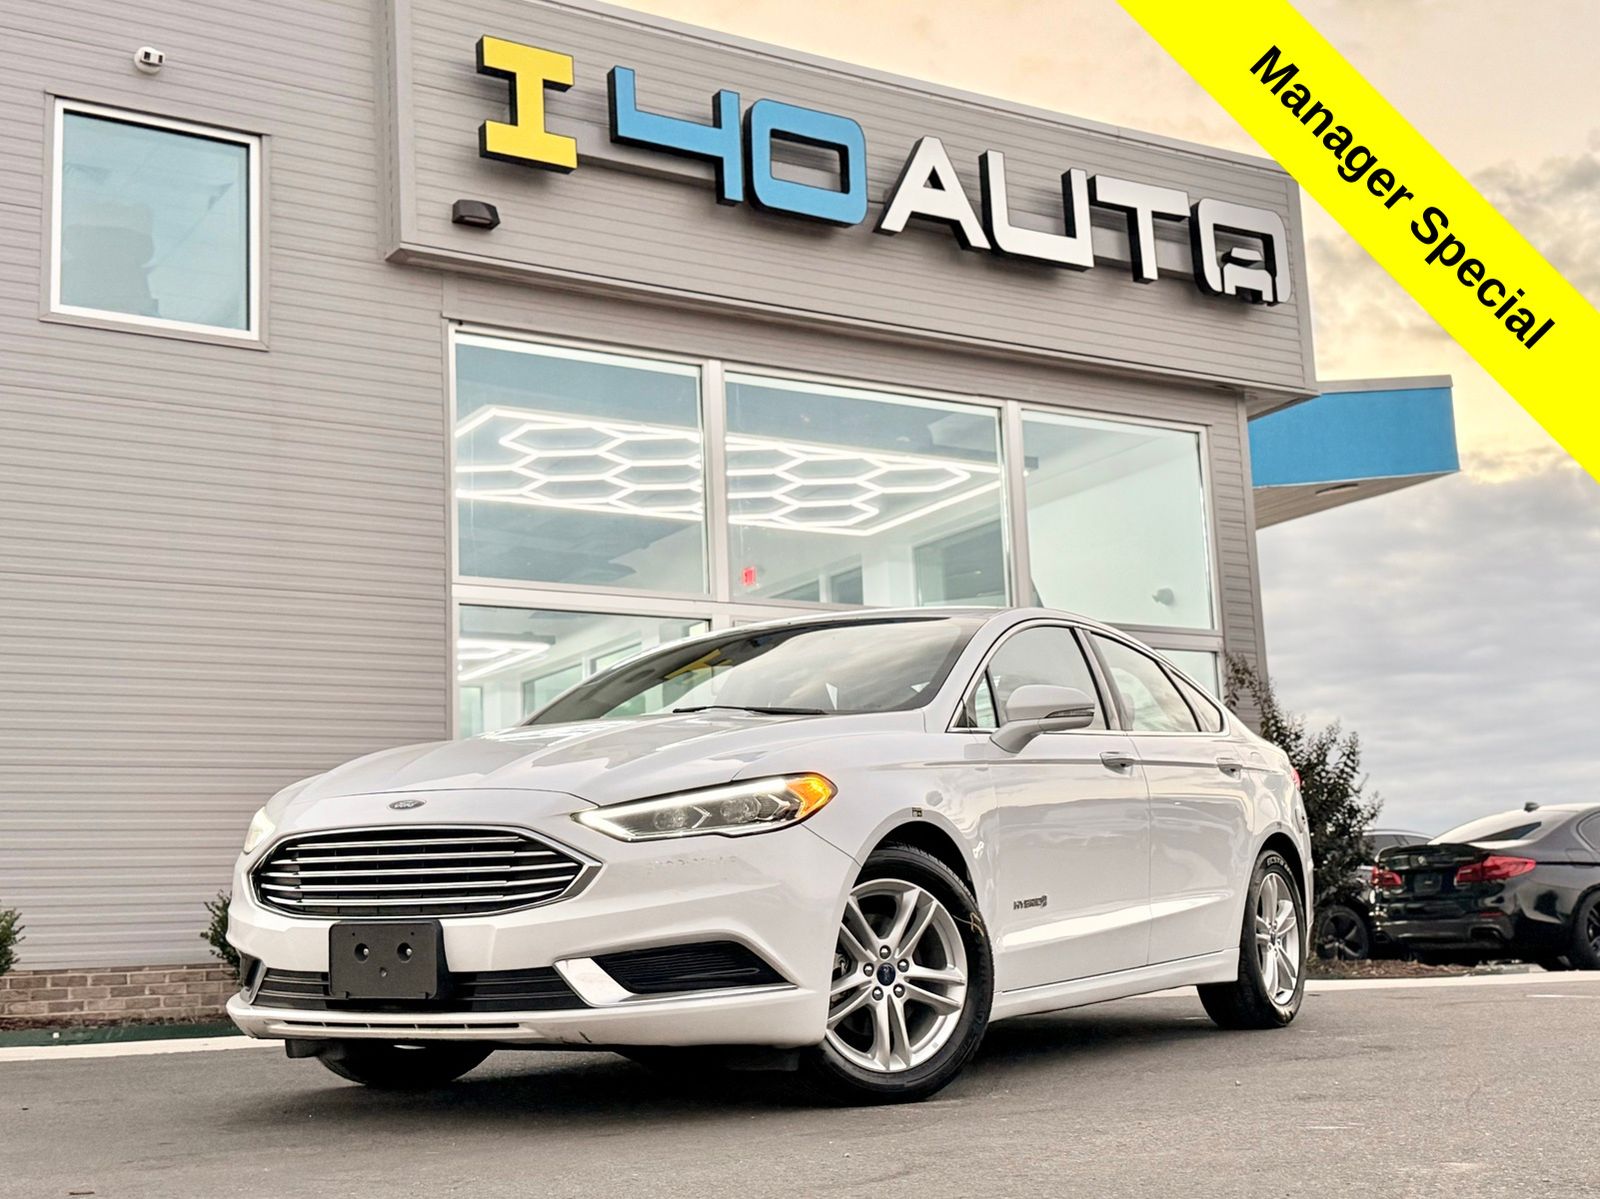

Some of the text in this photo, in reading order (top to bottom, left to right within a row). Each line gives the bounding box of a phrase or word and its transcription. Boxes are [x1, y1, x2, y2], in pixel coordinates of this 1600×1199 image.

[477, 35, 1292, 306] I 40 AUTO
